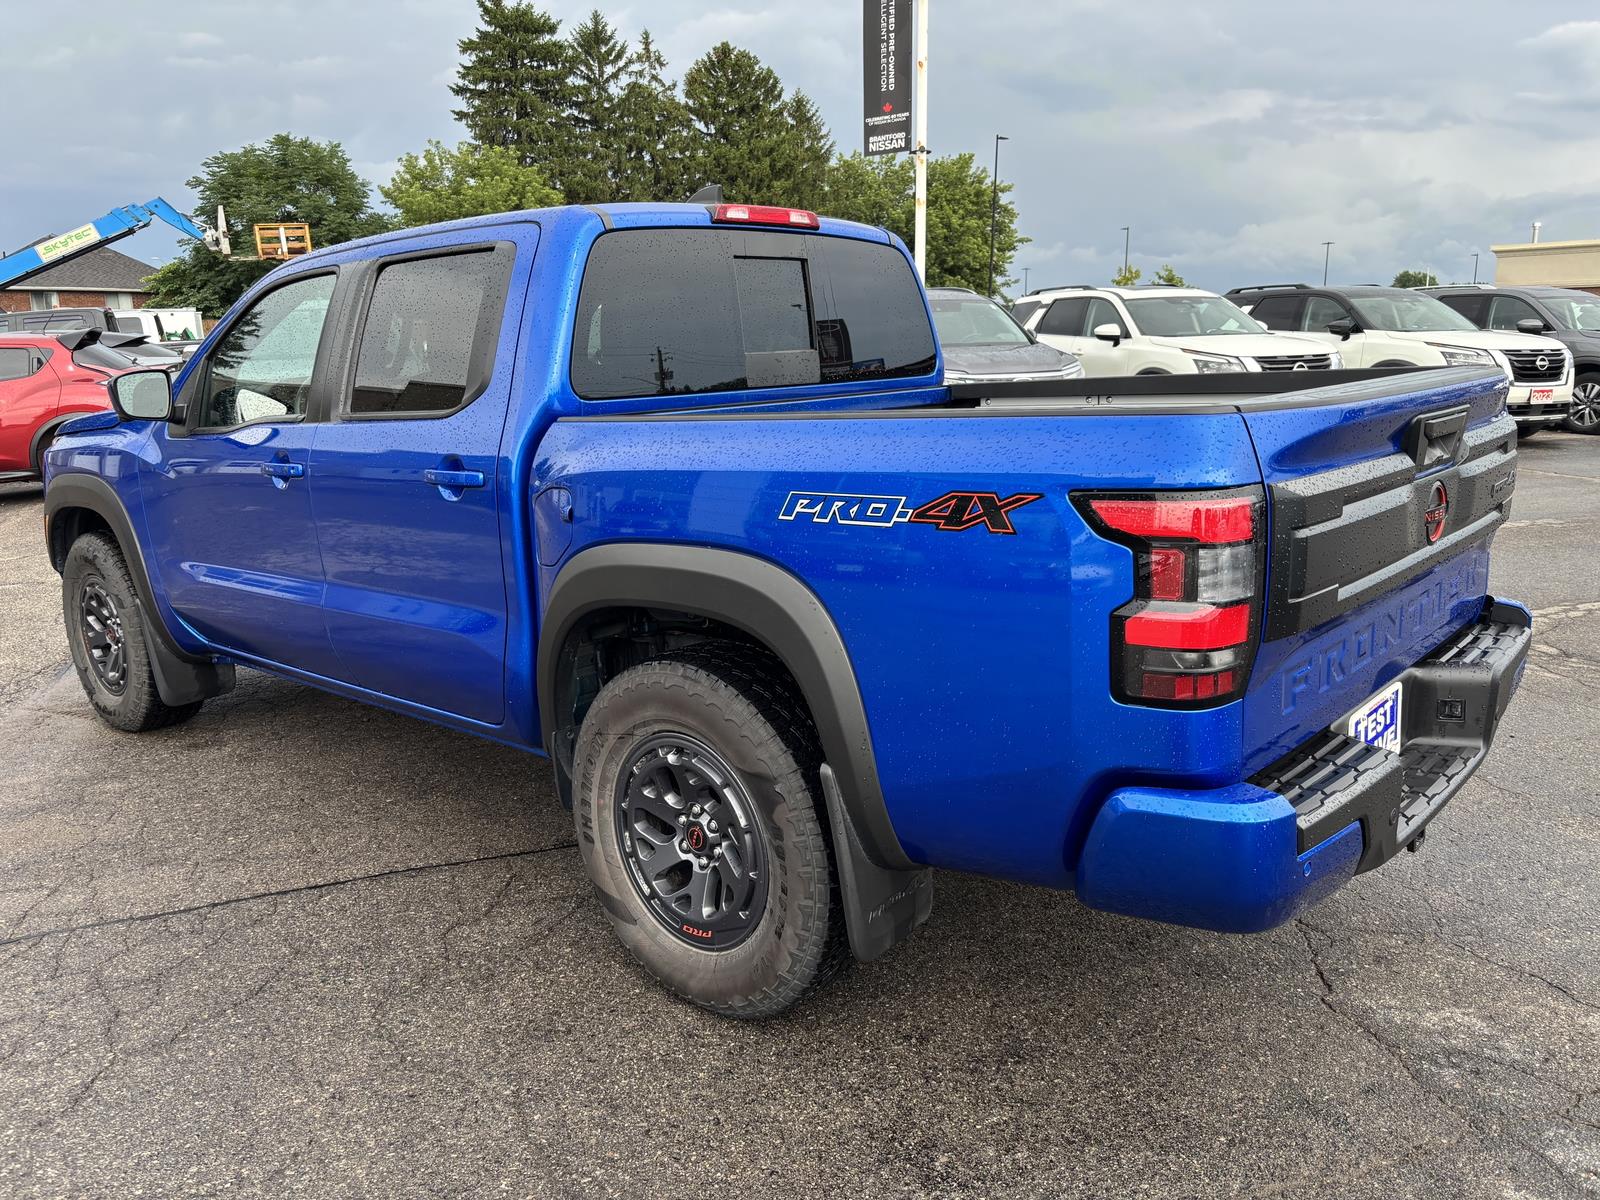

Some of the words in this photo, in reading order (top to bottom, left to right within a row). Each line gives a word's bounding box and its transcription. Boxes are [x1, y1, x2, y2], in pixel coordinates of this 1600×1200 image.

[869, 132, 906, 143] BRANTFORD
[869, 139, 906, 152] NISSAN
[43, 229, 91, 254] SKYTEC
[1533, 391, 1552, 400] 2023
[1357, 699, 1394, 743] TEST
[682, 924, 712, 938] PRO
